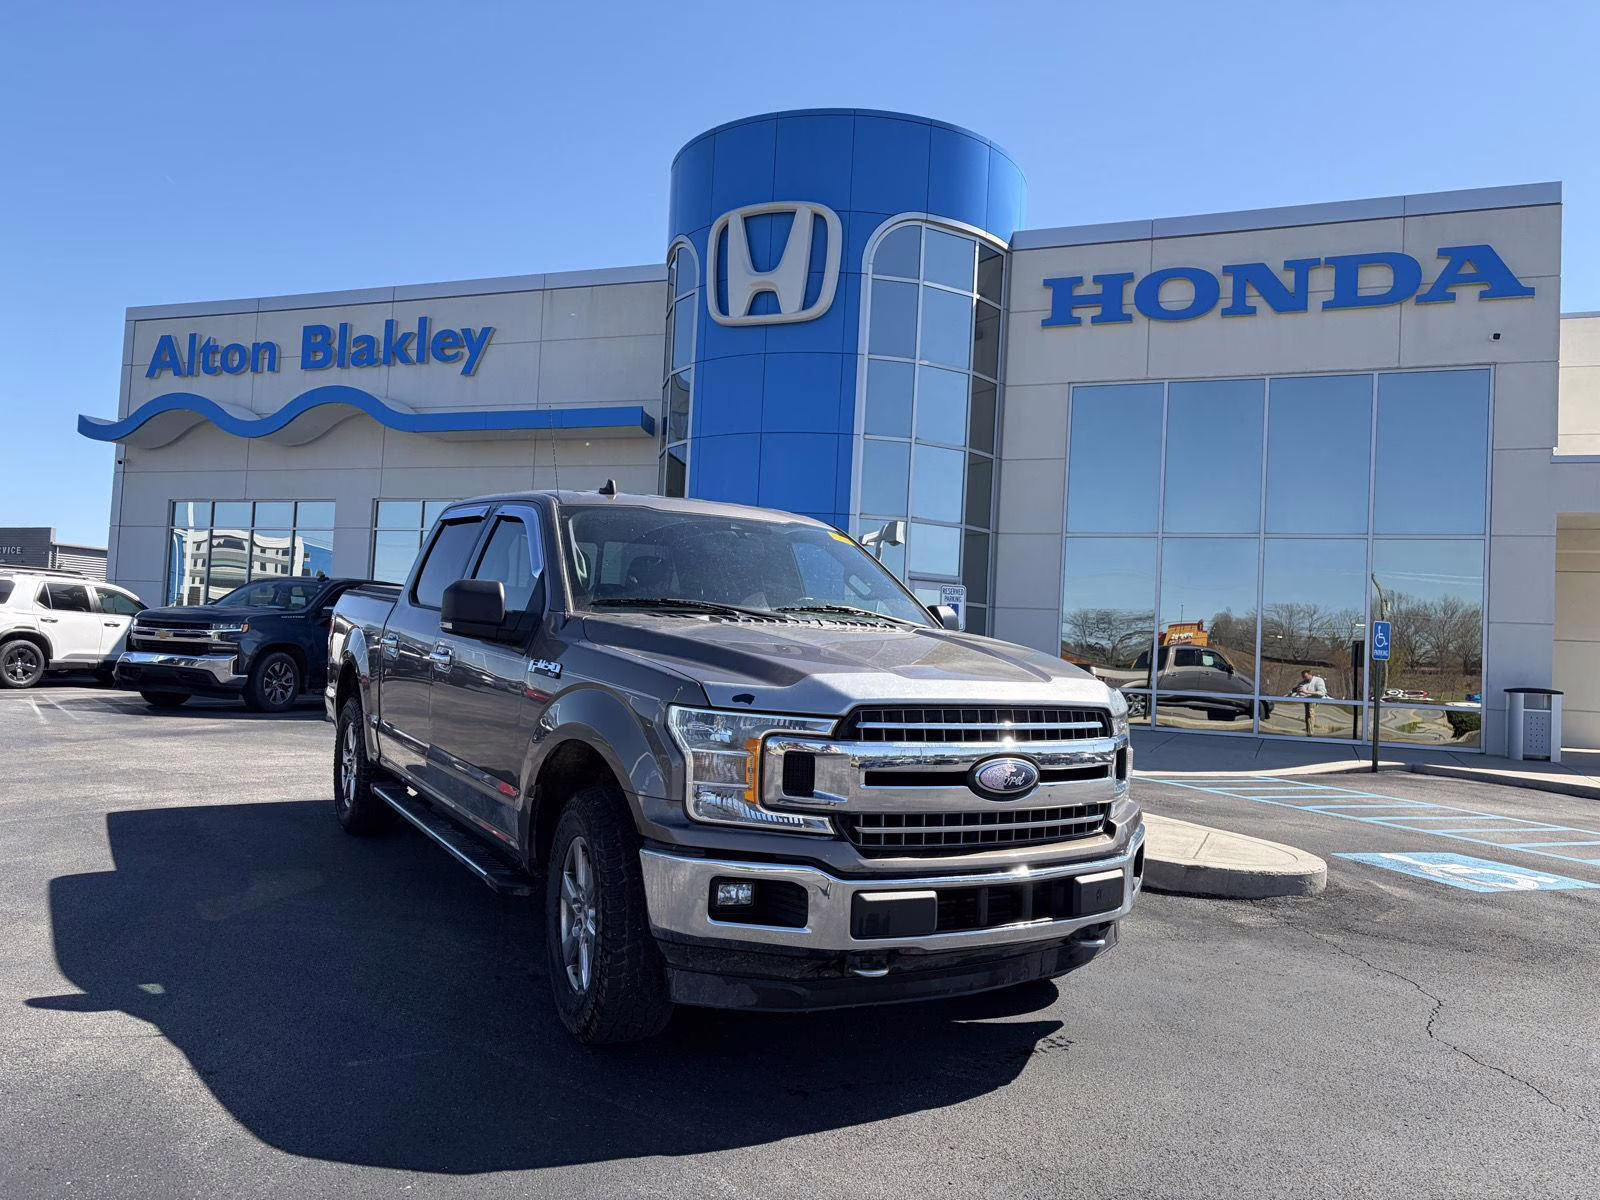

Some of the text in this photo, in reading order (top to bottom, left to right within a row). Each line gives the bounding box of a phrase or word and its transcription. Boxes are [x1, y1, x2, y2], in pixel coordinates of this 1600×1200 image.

[1041, 244, 1536, 328] HONDA
[145, 316, 496, 379] Alton Blakley
